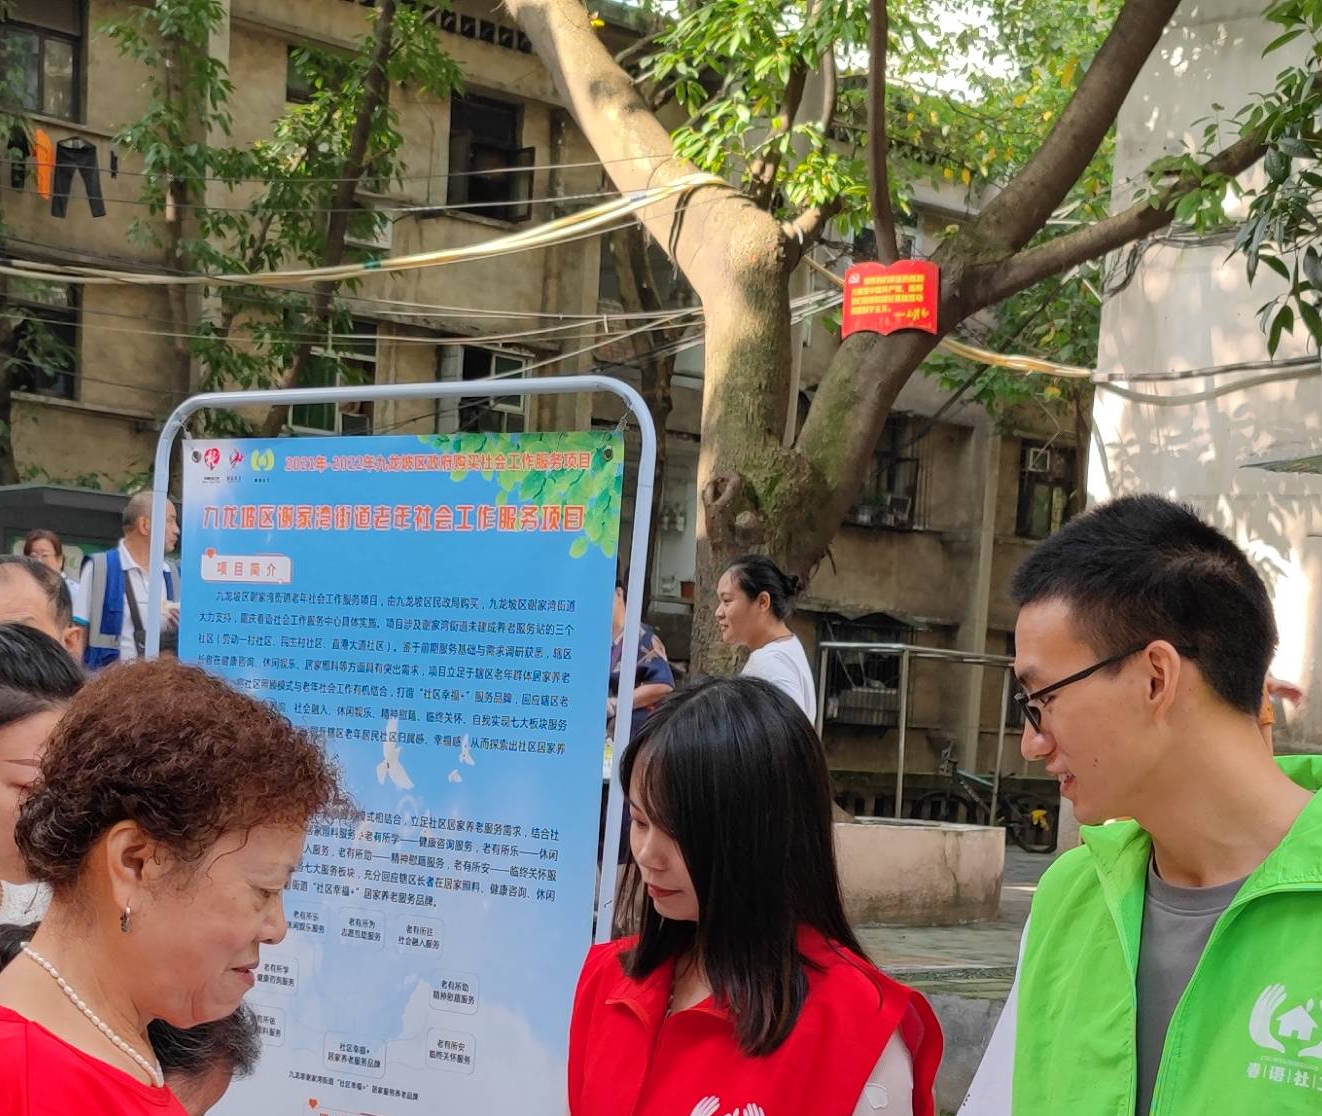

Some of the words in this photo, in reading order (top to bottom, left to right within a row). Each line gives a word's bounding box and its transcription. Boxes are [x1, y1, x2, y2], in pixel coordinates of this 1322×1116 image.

[284, 452, 592, 473] 2021年-2022年九龙坡区政府购买社会工作服务项目
[202, 503, 586, 532] 九龙坡区谢家湾街道老年社会工作服务项目
[217, 561, 277, 577] 项目简介
